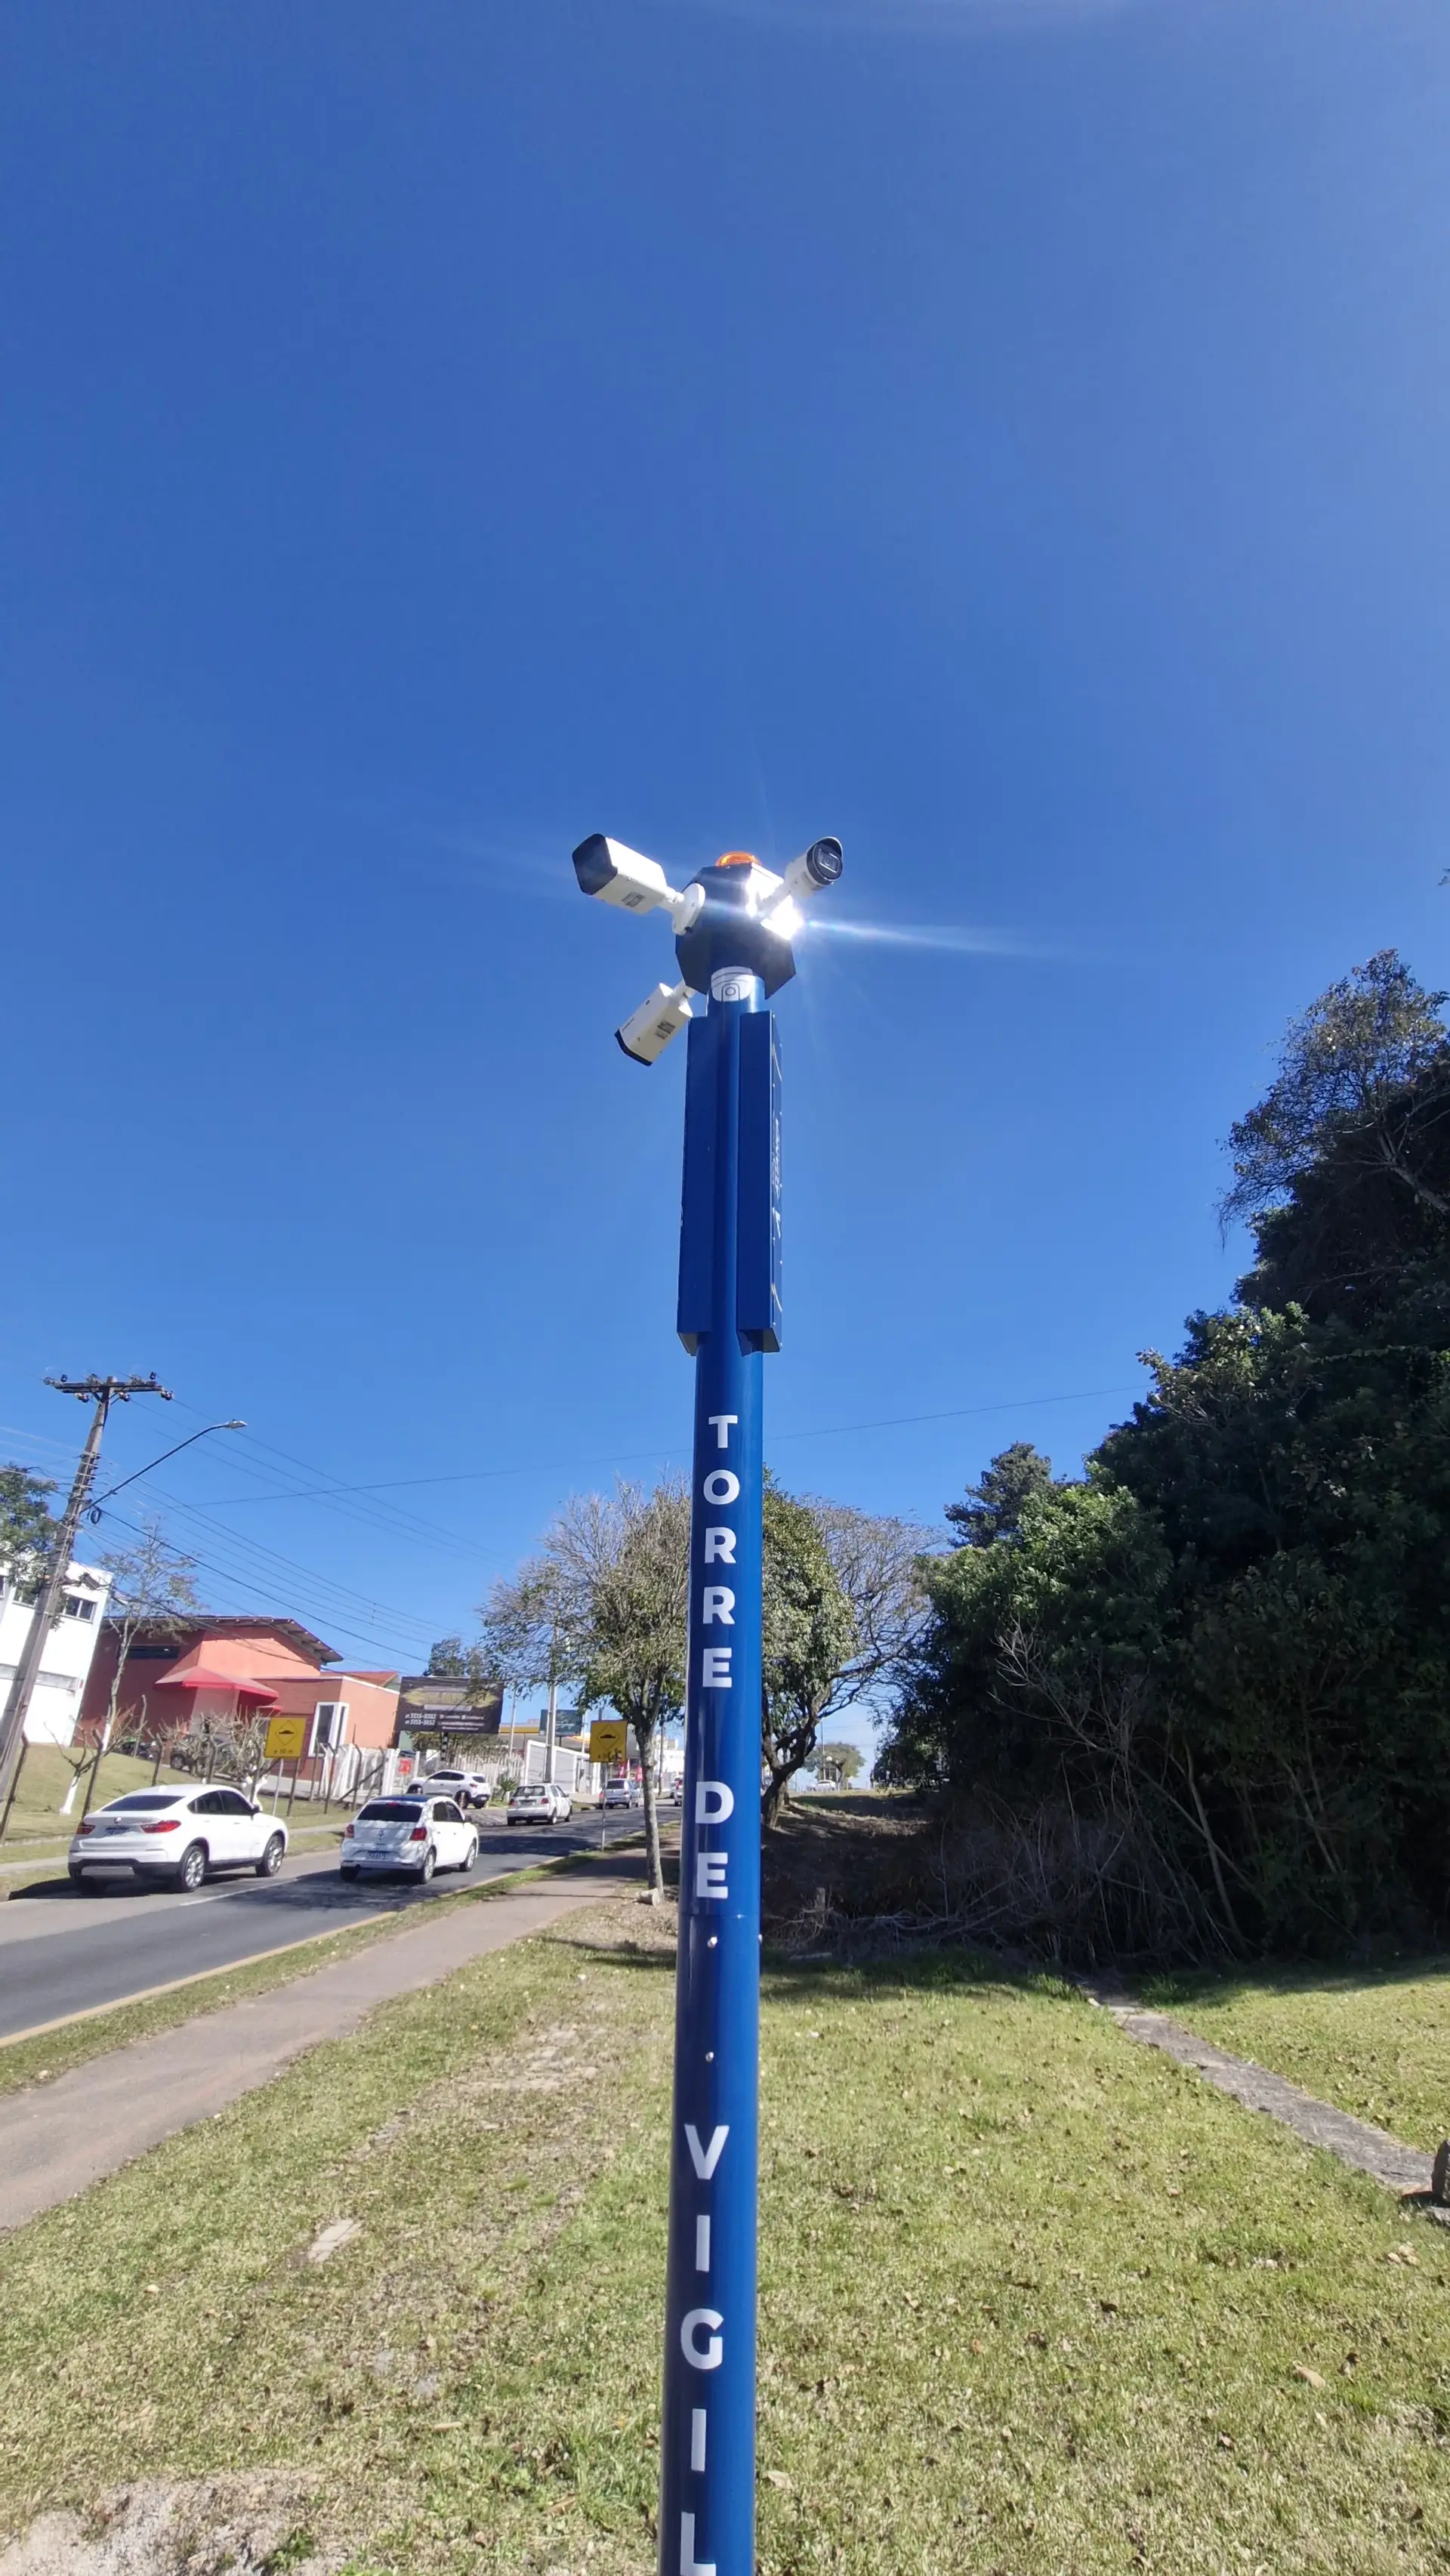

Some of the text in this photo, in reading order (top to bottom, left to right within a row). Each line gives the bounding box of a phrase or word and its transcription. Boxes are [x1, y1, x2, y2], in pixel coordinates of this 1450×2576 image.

[680, 1414, 740, 2576] TORRE DE VIGIL
